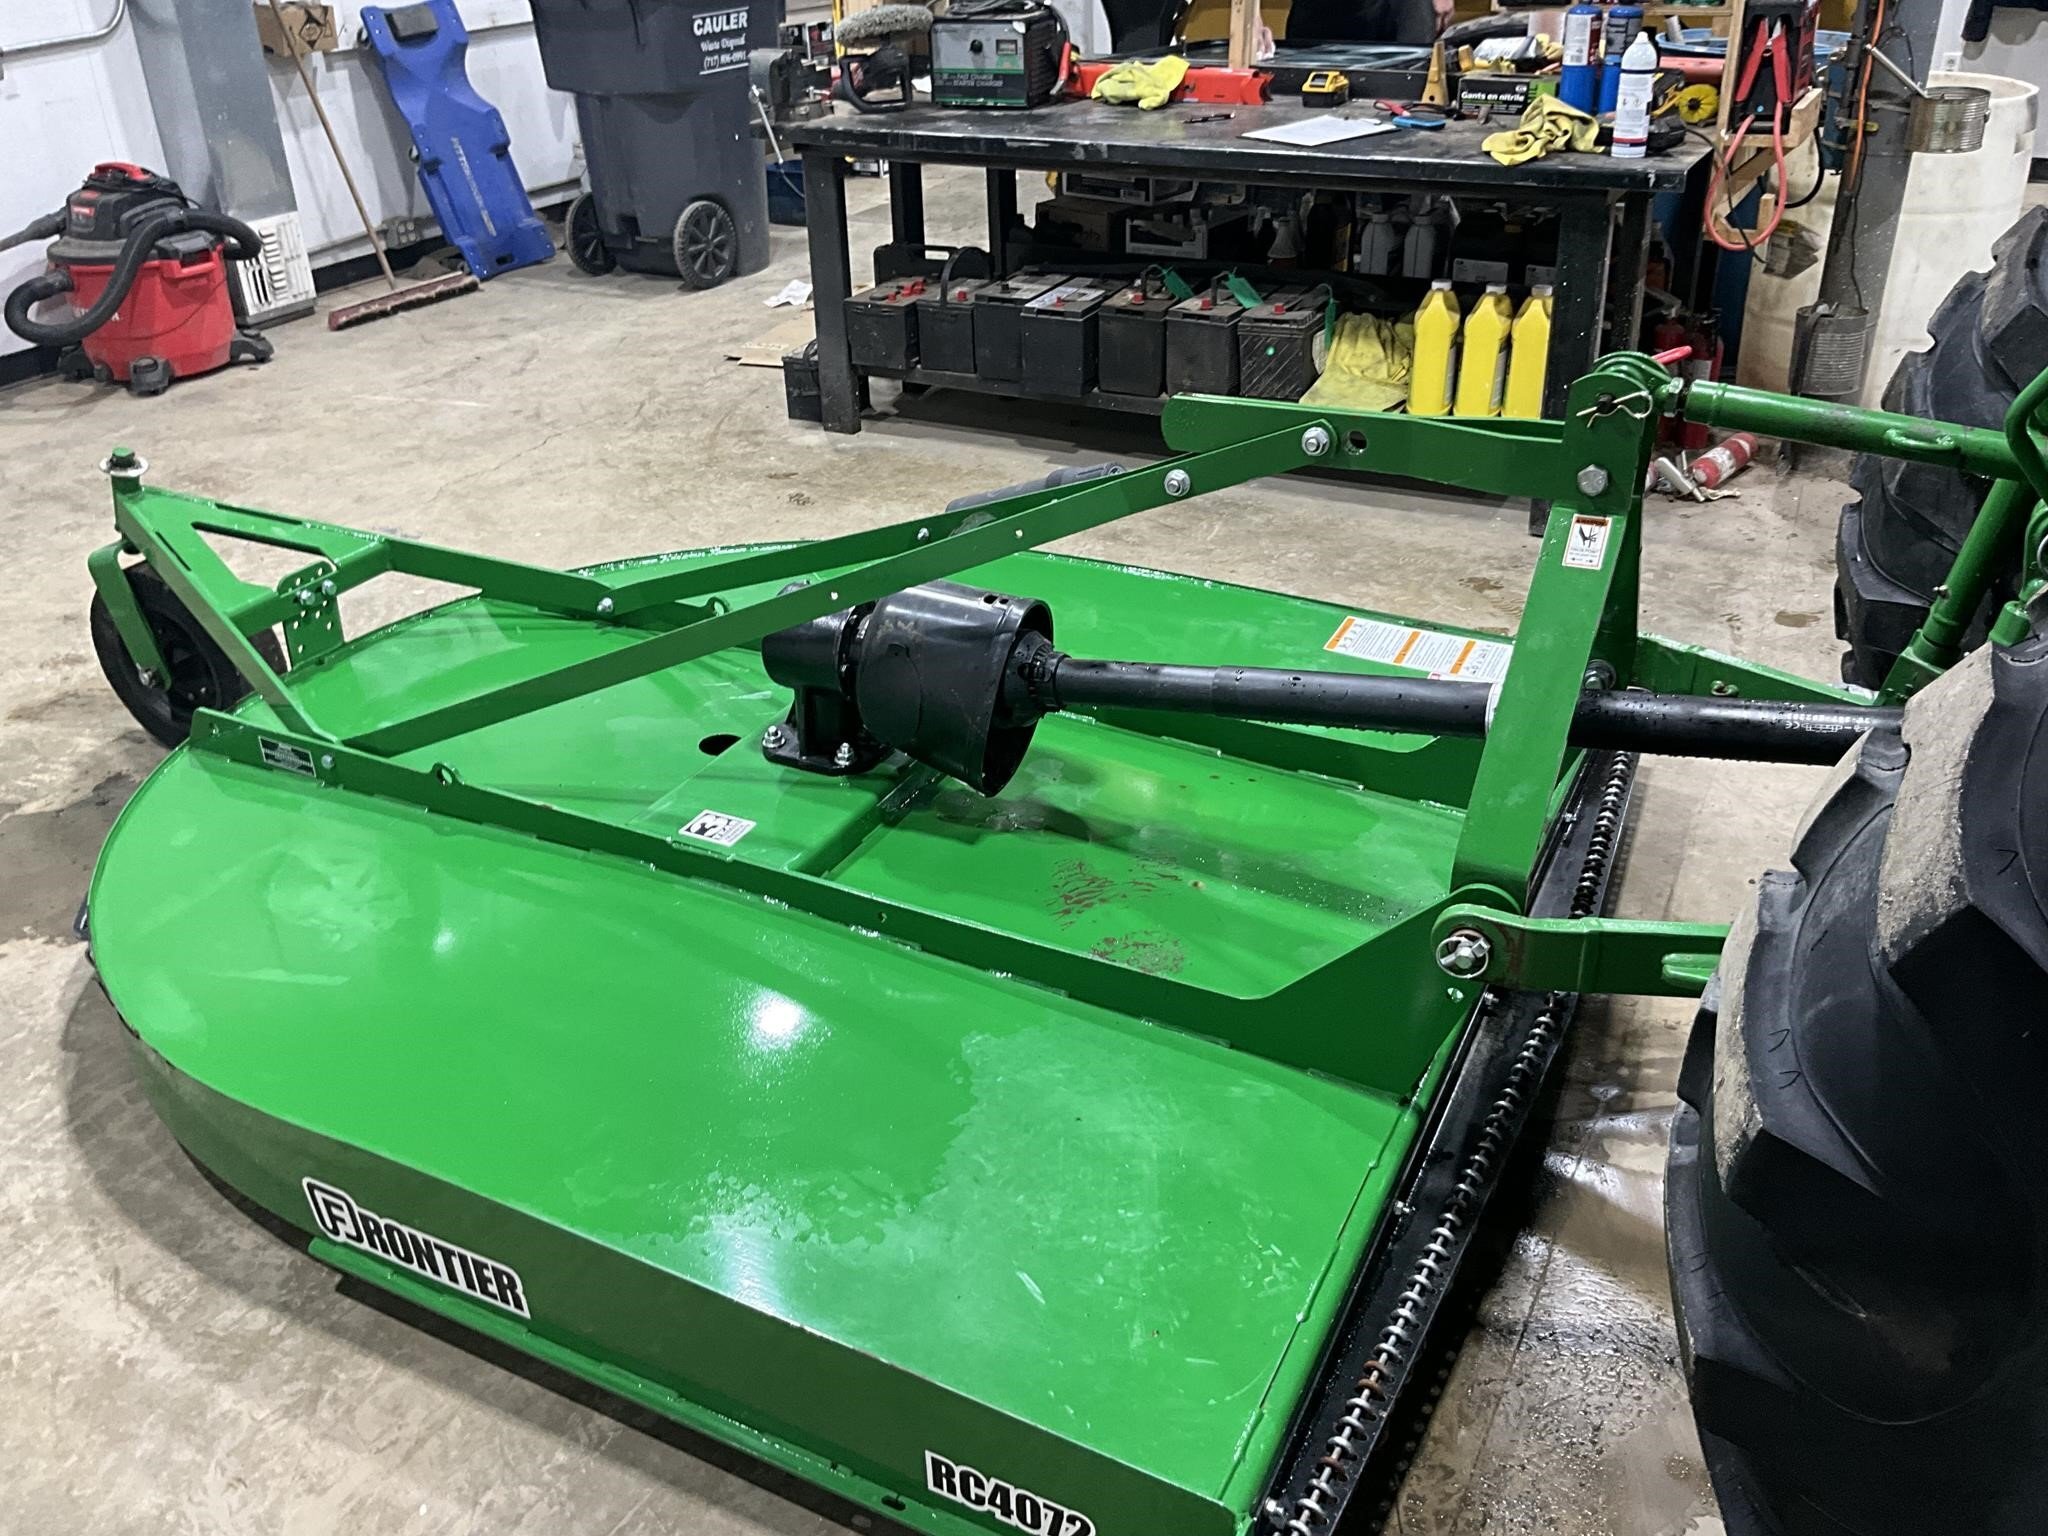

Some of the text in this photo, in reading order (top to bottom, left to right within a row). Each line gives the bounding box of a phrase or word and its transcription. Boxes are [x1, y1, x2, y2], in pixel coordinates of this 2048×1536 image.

[693, 11, 748, 37] CAULER
[1461, 91, 1526, 102] Gants en nitrile
[306, 1180, 527, 1313] FRONTIER
[930, 1455, 1092, 1536] RC4072
